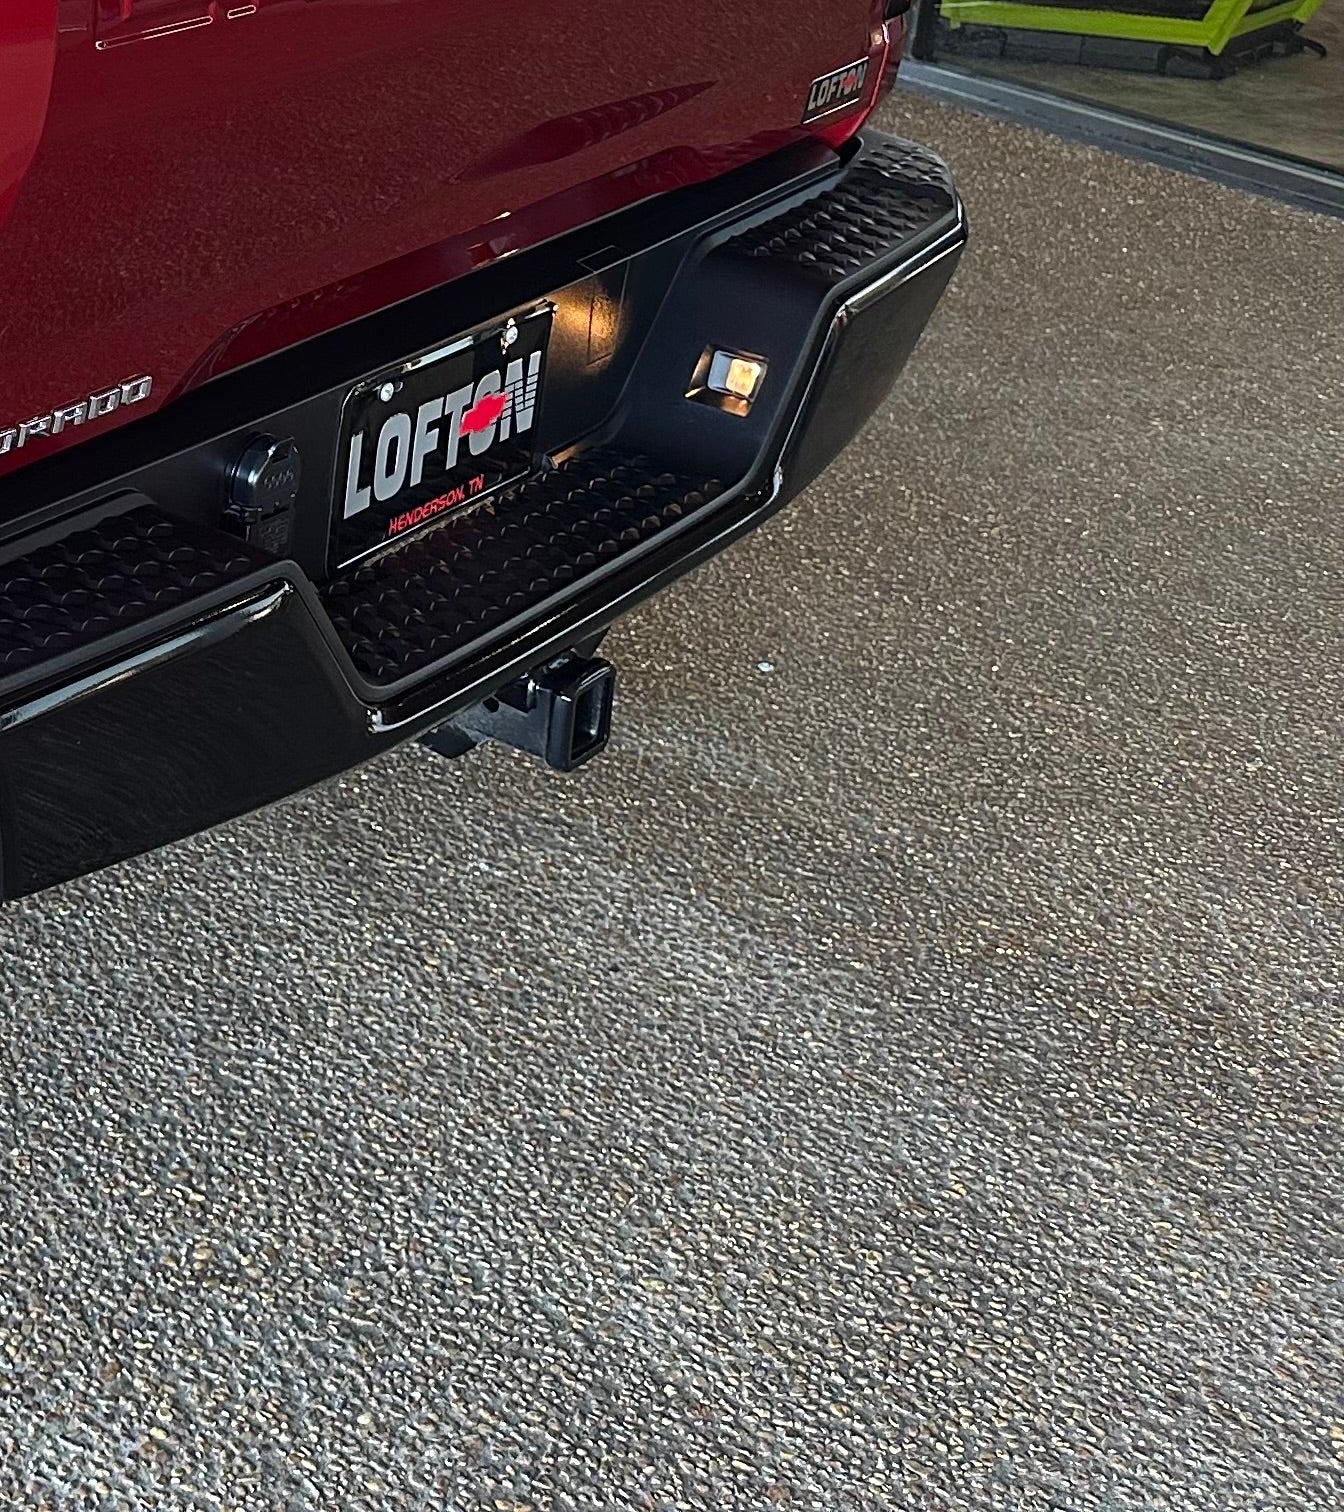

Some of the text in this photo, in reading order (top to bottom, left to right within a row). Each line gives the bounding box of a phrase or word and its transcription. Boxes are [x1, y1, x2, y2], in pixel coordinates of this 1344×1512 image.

[807, 62, 868, 111] LOFTON
[343, 350, 542, 520] LOFTON
[469, 474, 485, 496] TN
